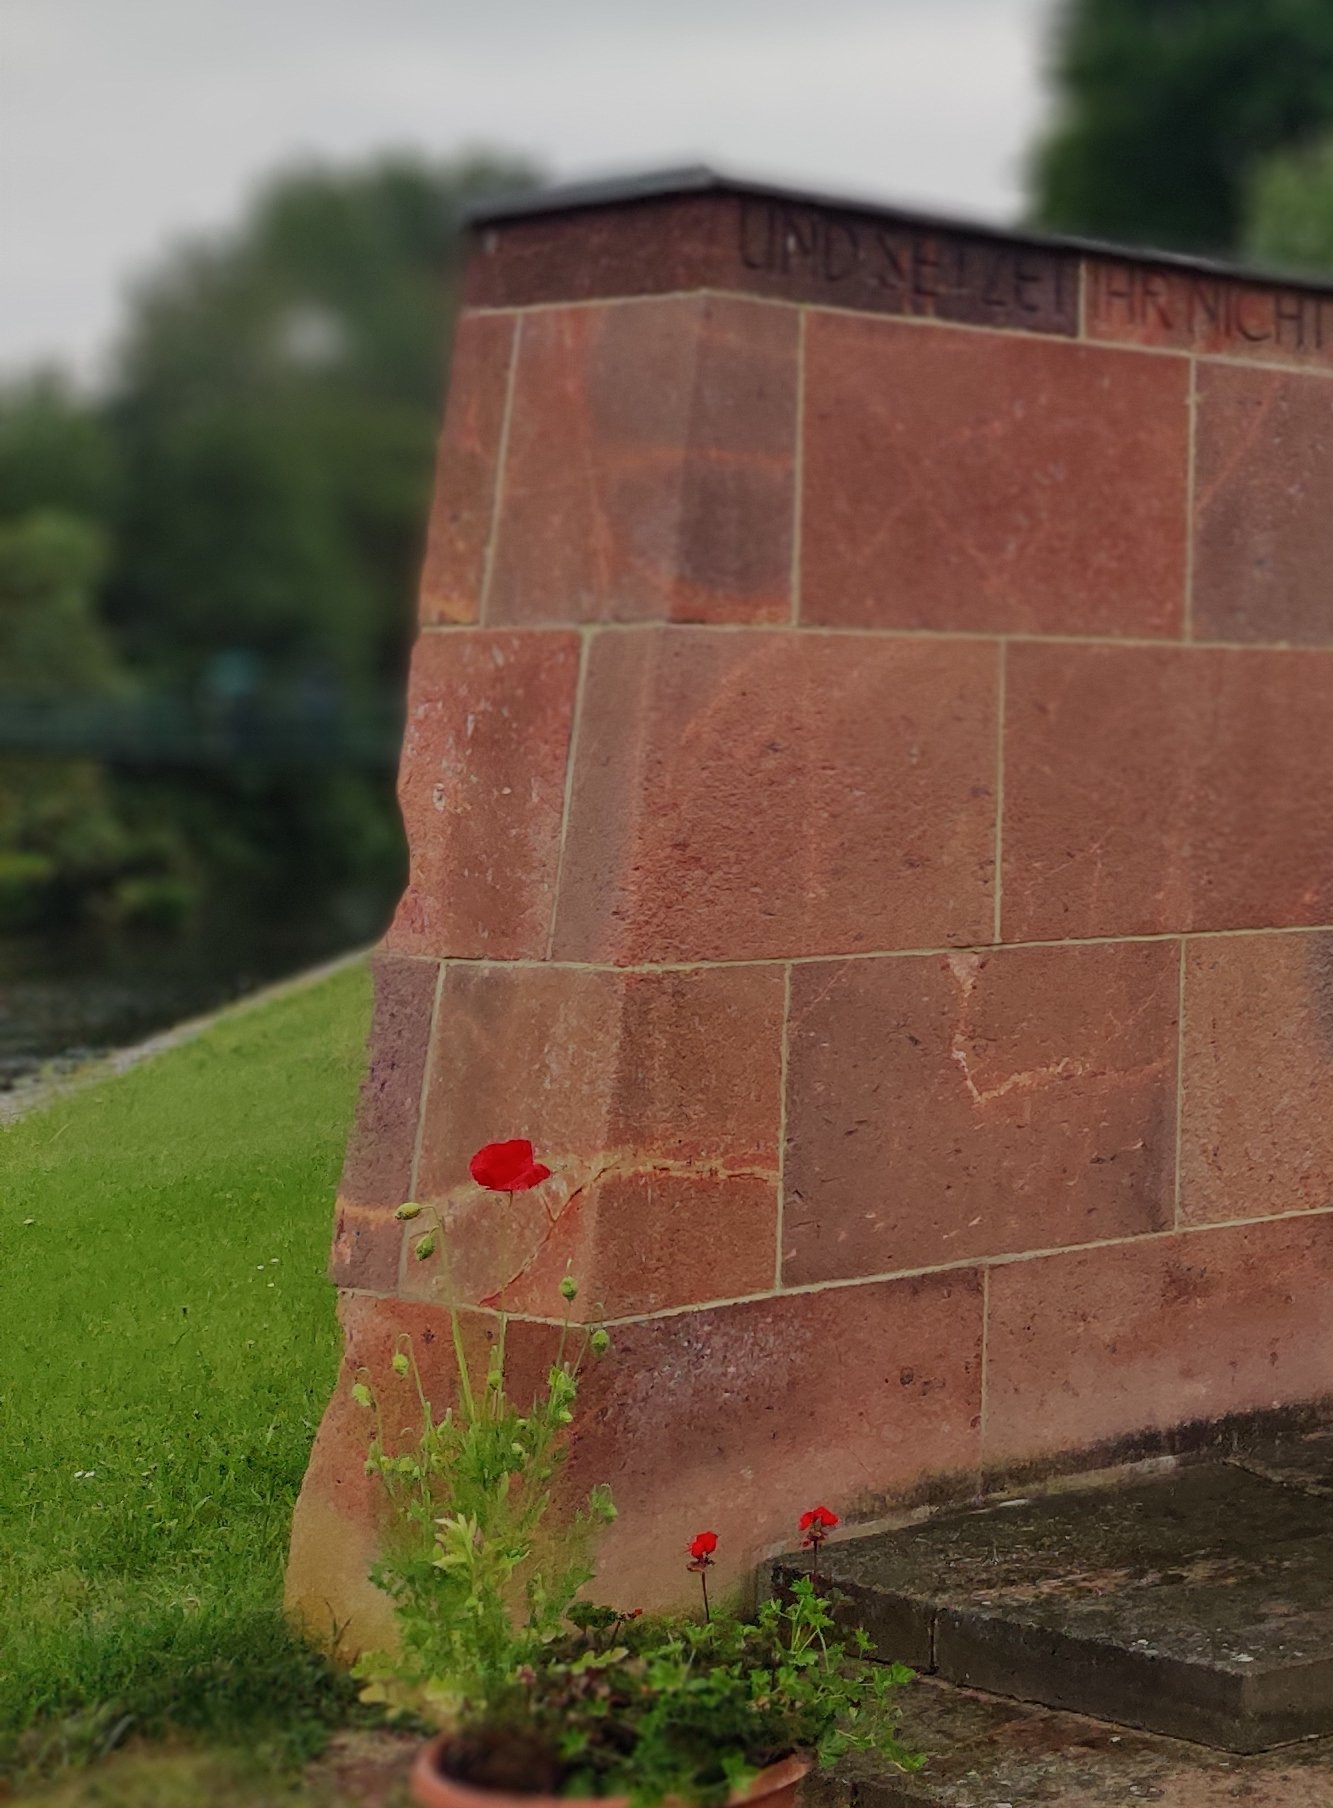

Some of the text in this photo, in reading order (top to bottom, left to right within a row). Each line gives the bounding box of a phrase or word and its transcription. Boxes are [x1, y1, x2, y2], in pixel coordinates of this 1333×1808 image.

[738, 196, 863, 283] UND
[1090, 258, 1172, 332] IHR
[1183, 275, 1330, 350] NICHT
